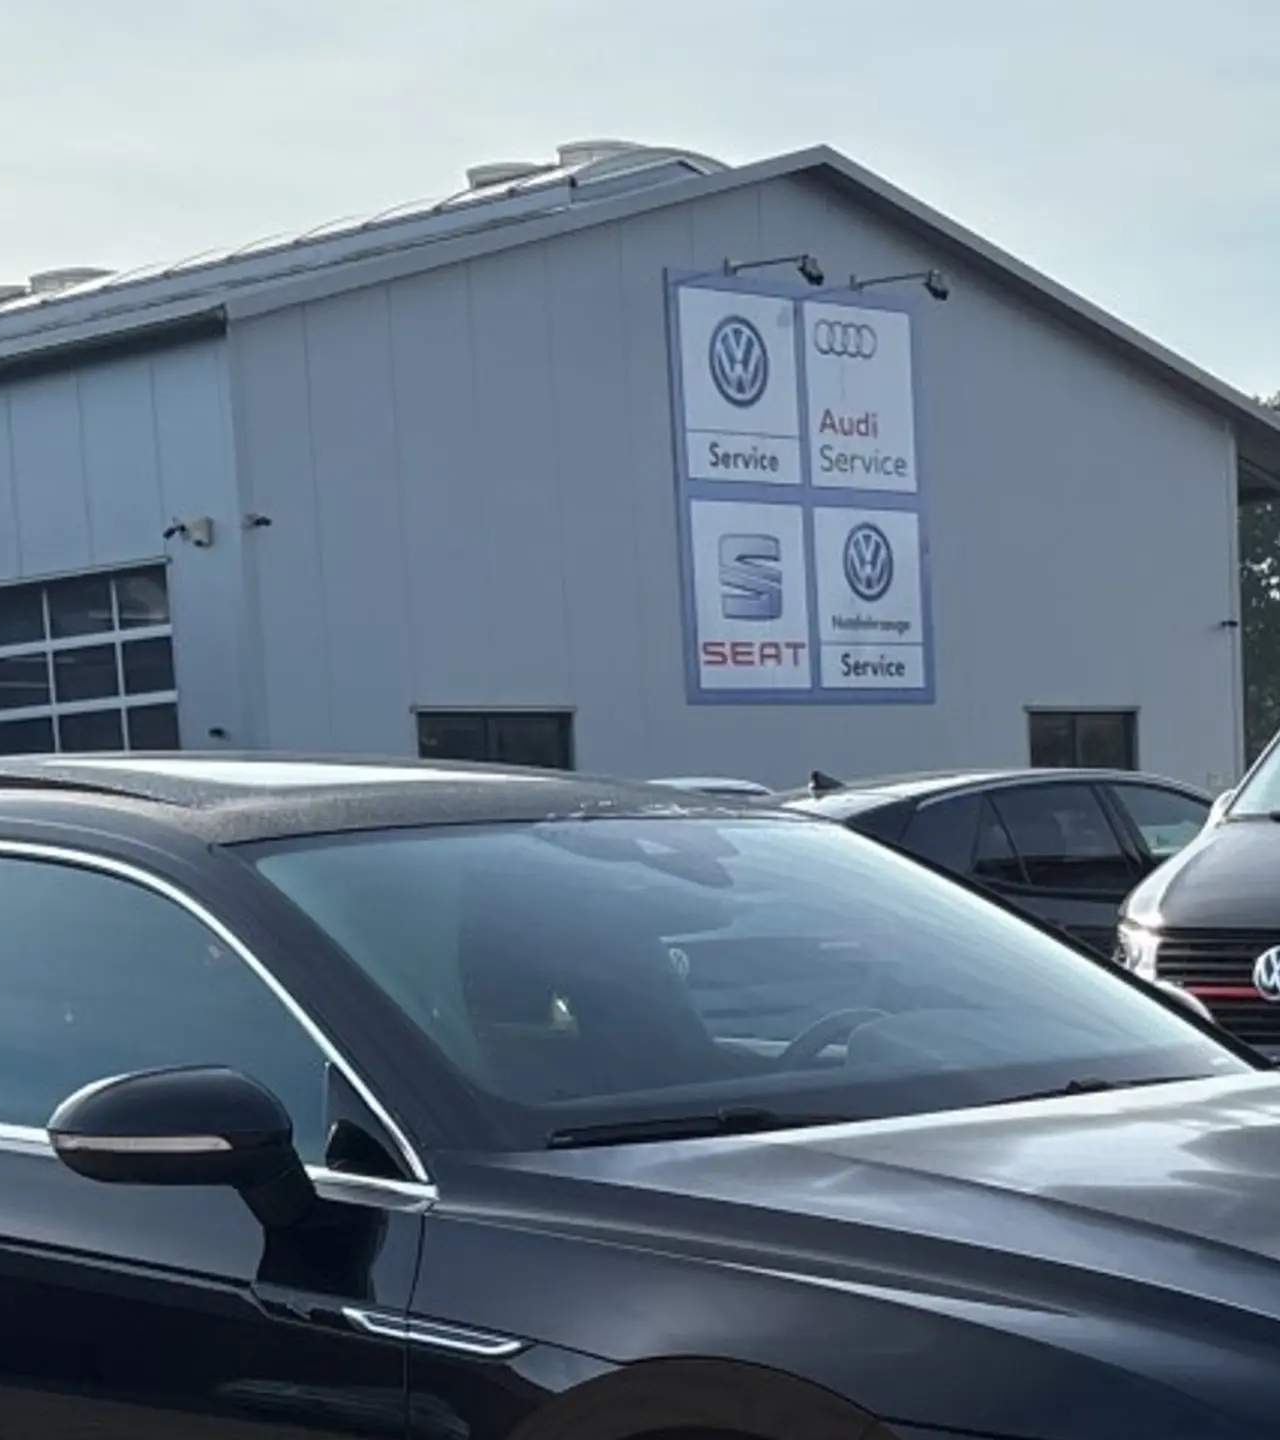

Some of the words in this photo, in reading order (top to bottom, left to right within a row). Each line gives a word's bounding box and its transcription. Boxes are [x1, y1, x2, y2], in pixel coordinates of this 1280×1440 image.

[820, 408, 878, 438] Audi
[709, 442, 780, 472] Service
[820, 443, 908, 477] Service
[702, 641, 806, 667] SEAT
[841, 653, 905, 677] Service
